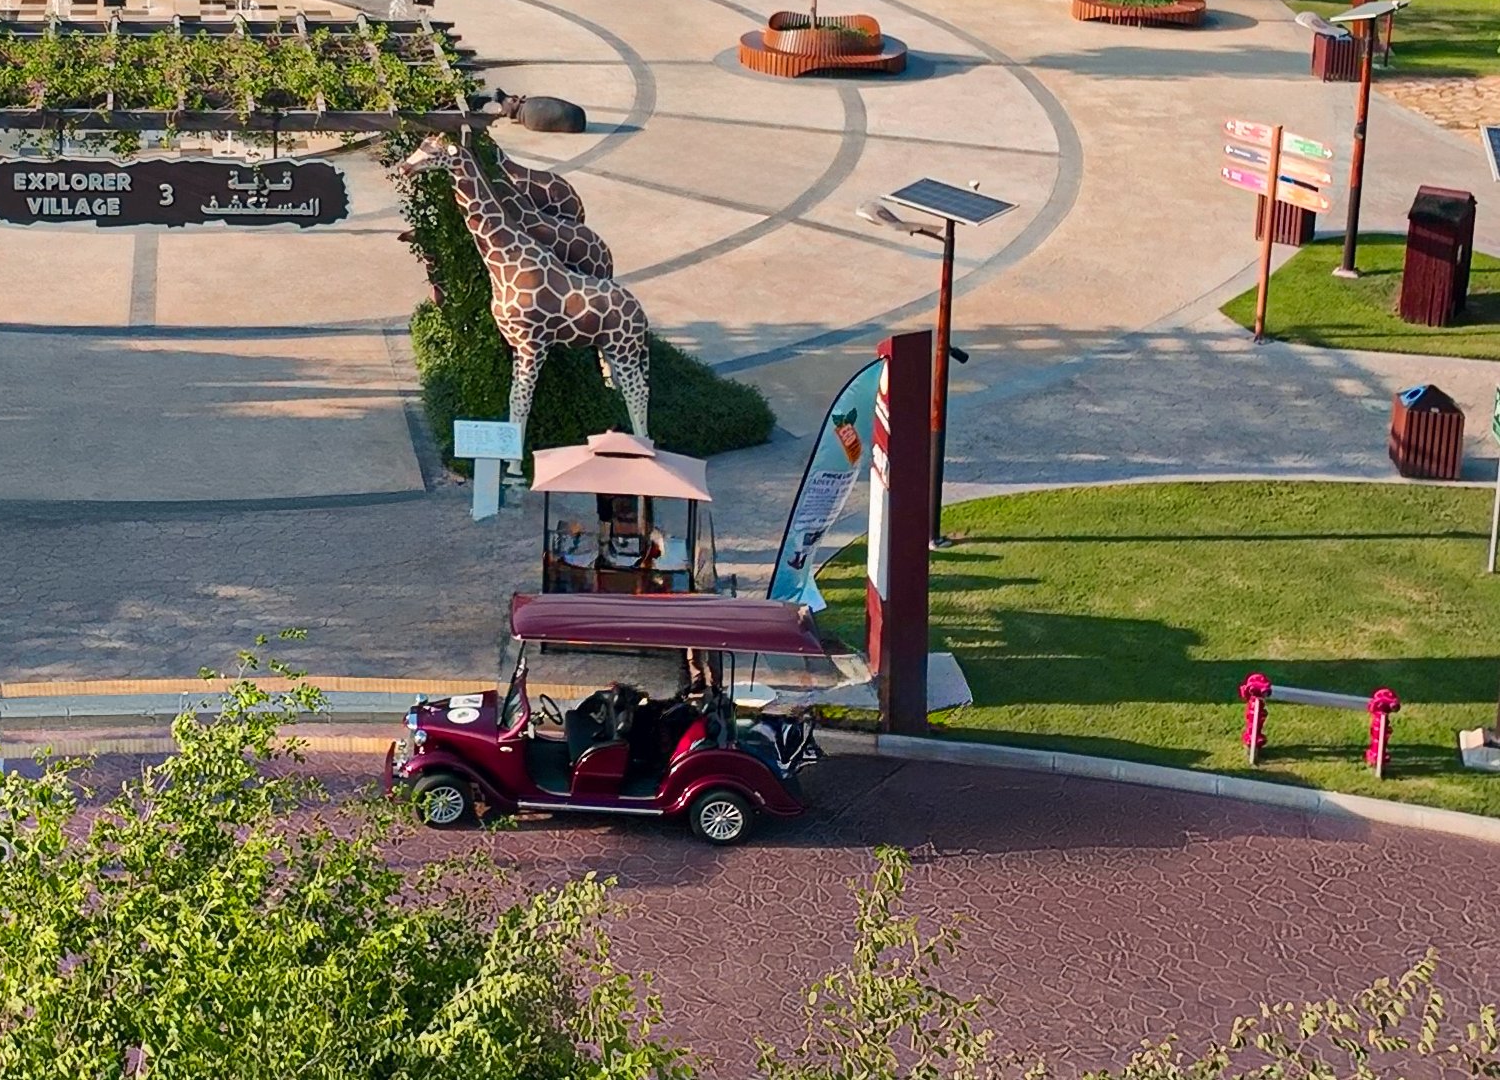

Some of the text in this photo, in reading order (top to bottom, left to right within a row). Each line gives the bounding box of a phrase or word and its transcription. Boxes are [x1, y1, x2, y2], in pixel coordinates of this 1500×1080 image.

[13, 172, 132, 192] EXPLORER
[227, 170, 293, 196] قرية
[159, 183, 174, 206] 3
[26, 197, 121, 216] VILLAGE
[200, 195, 320, 217] المستكشف
